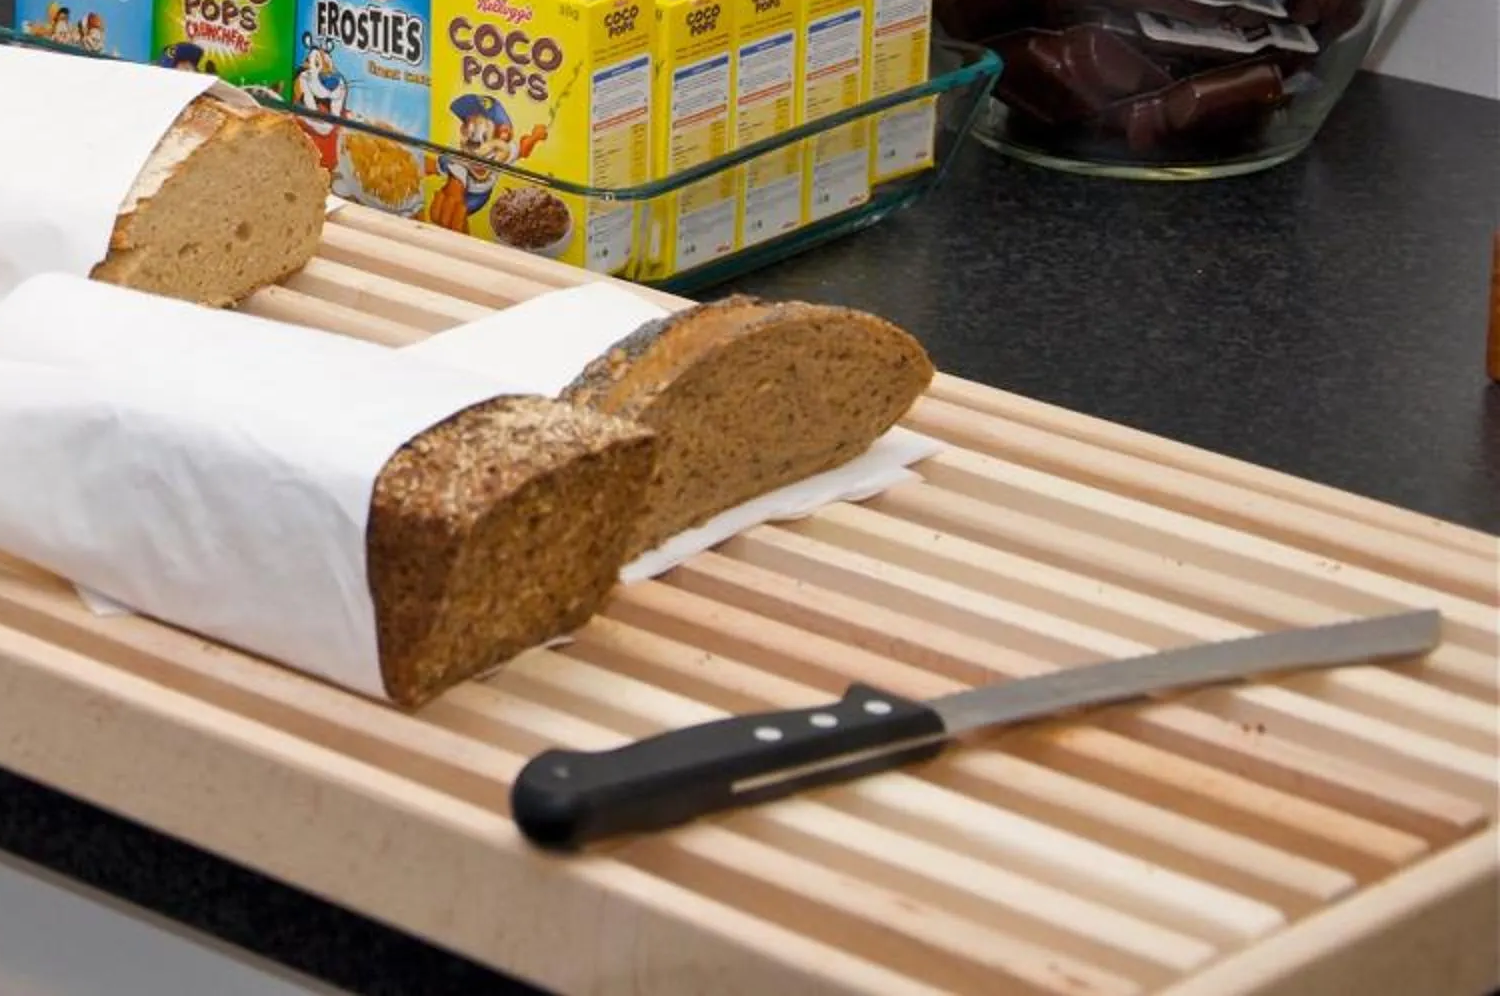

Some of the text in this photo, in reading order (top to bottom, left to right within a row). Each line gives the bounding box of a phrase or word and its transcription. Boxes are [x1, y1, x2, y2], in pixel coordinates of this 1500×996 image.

[315, 0, 423, 64] FROSTIES
[604, 4, 639, 28] COCO
[685, 4, 721, 27] COCO
[449, 15, 564, 72] COCO
[463, 55, 550, 101] POPS
